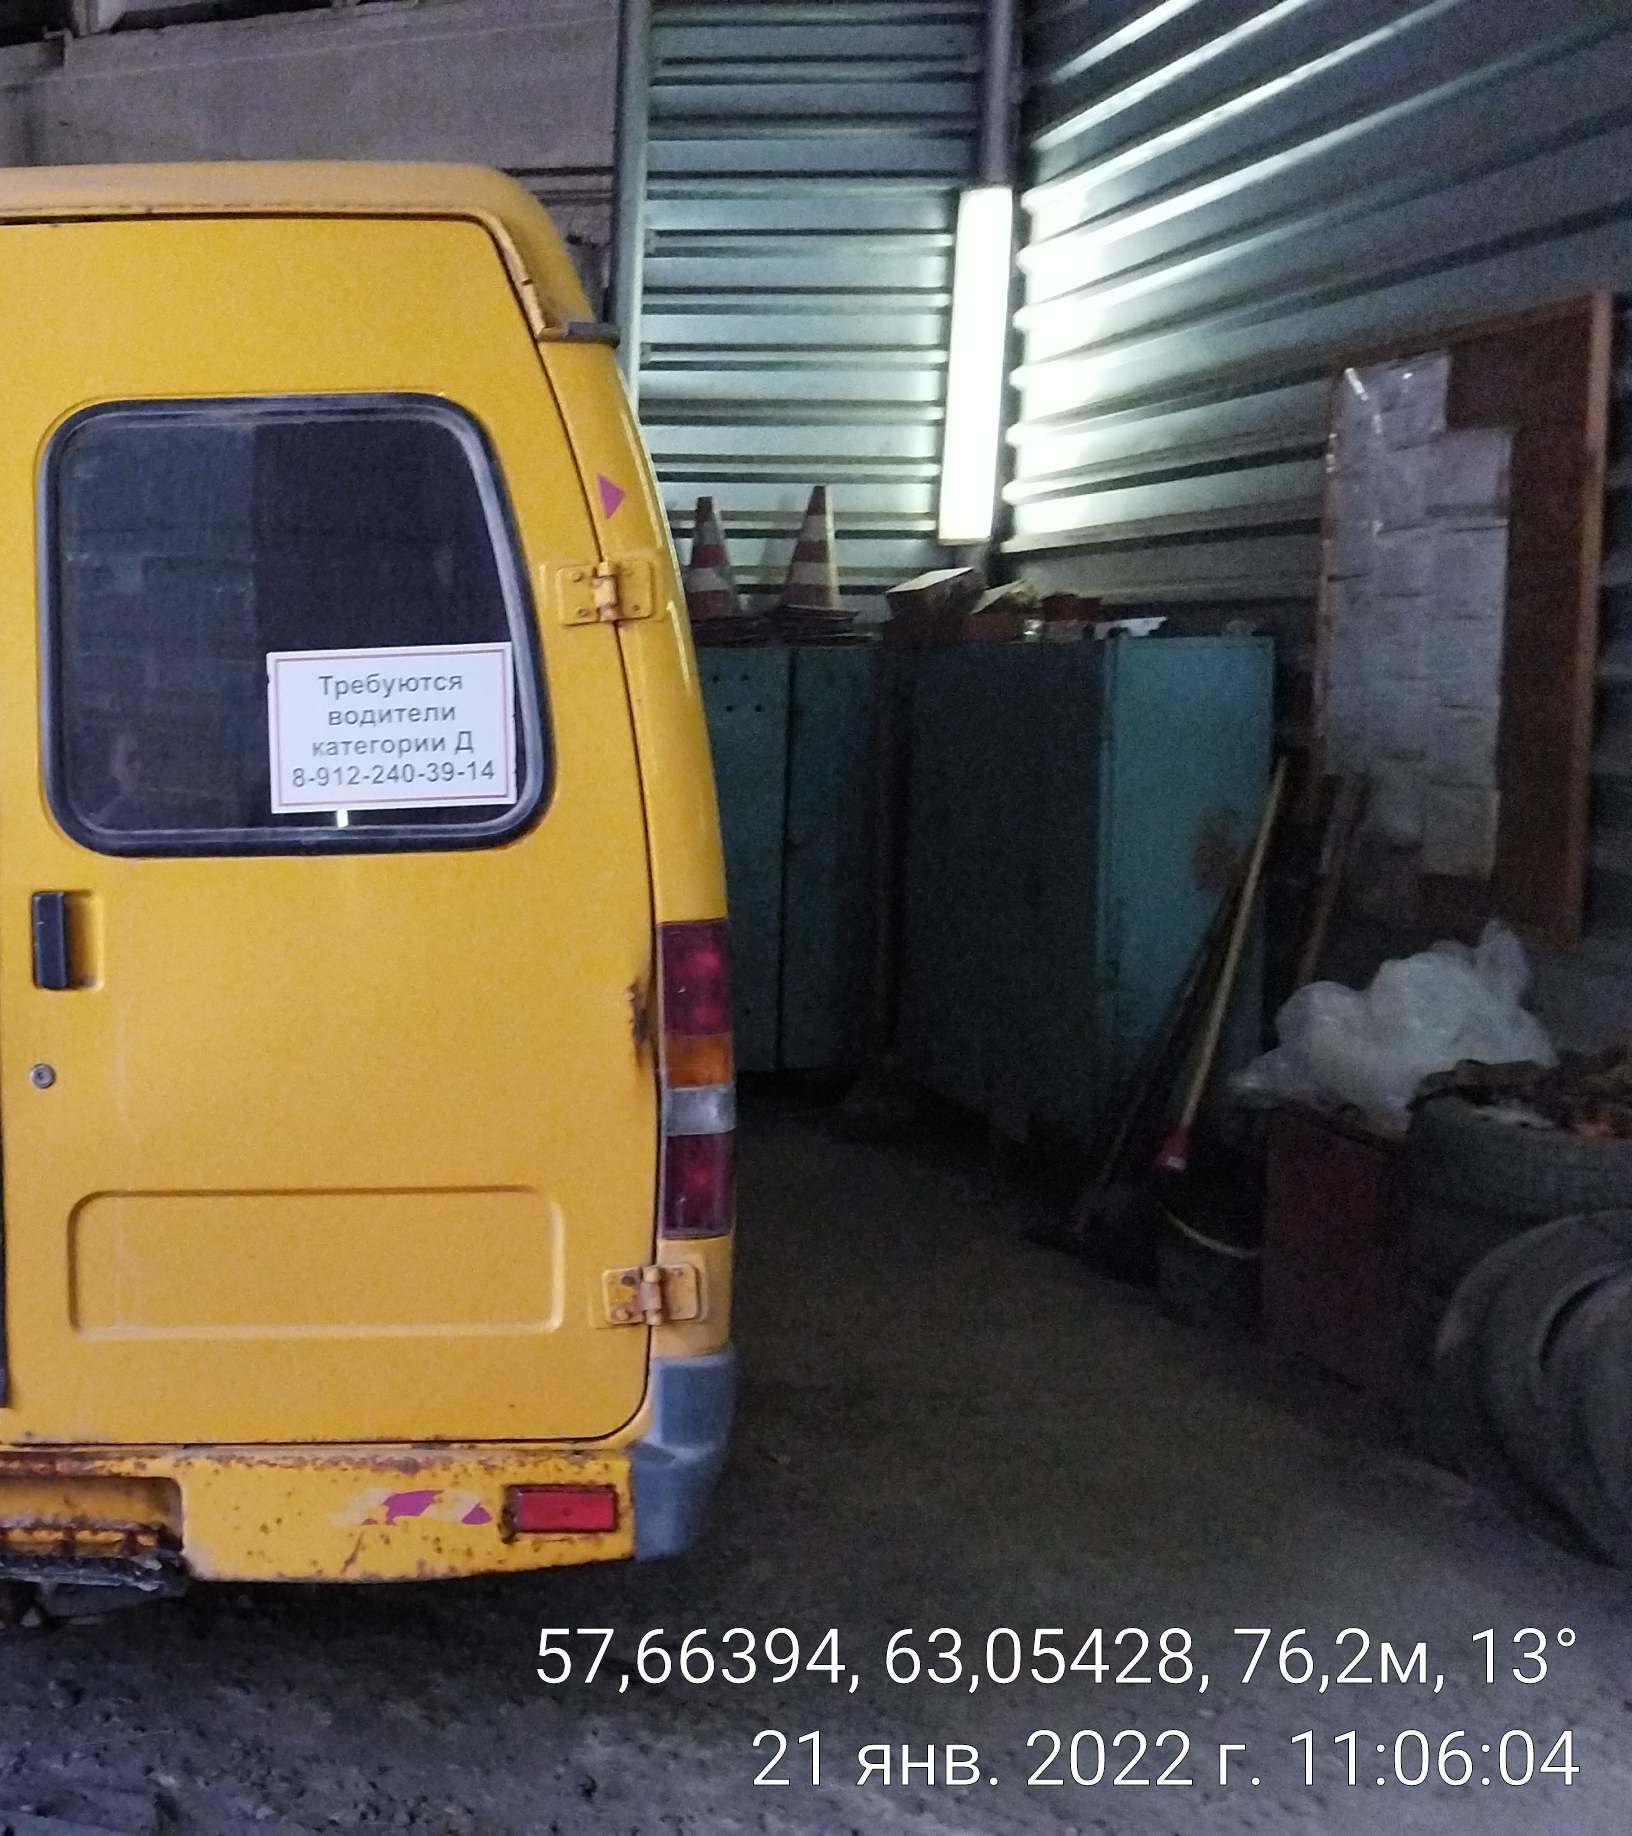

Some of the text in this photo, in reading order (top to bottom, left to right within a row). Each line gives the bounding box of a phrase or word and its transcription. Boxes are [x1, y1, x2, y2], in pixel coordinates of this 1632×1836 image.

[318, 673, 464, 701] Требуются
[328, 705, 457, 728] водители
[311, 730, 475, 759] категории Д
[291, 759, 496, 788] 8-912-240-39-14
